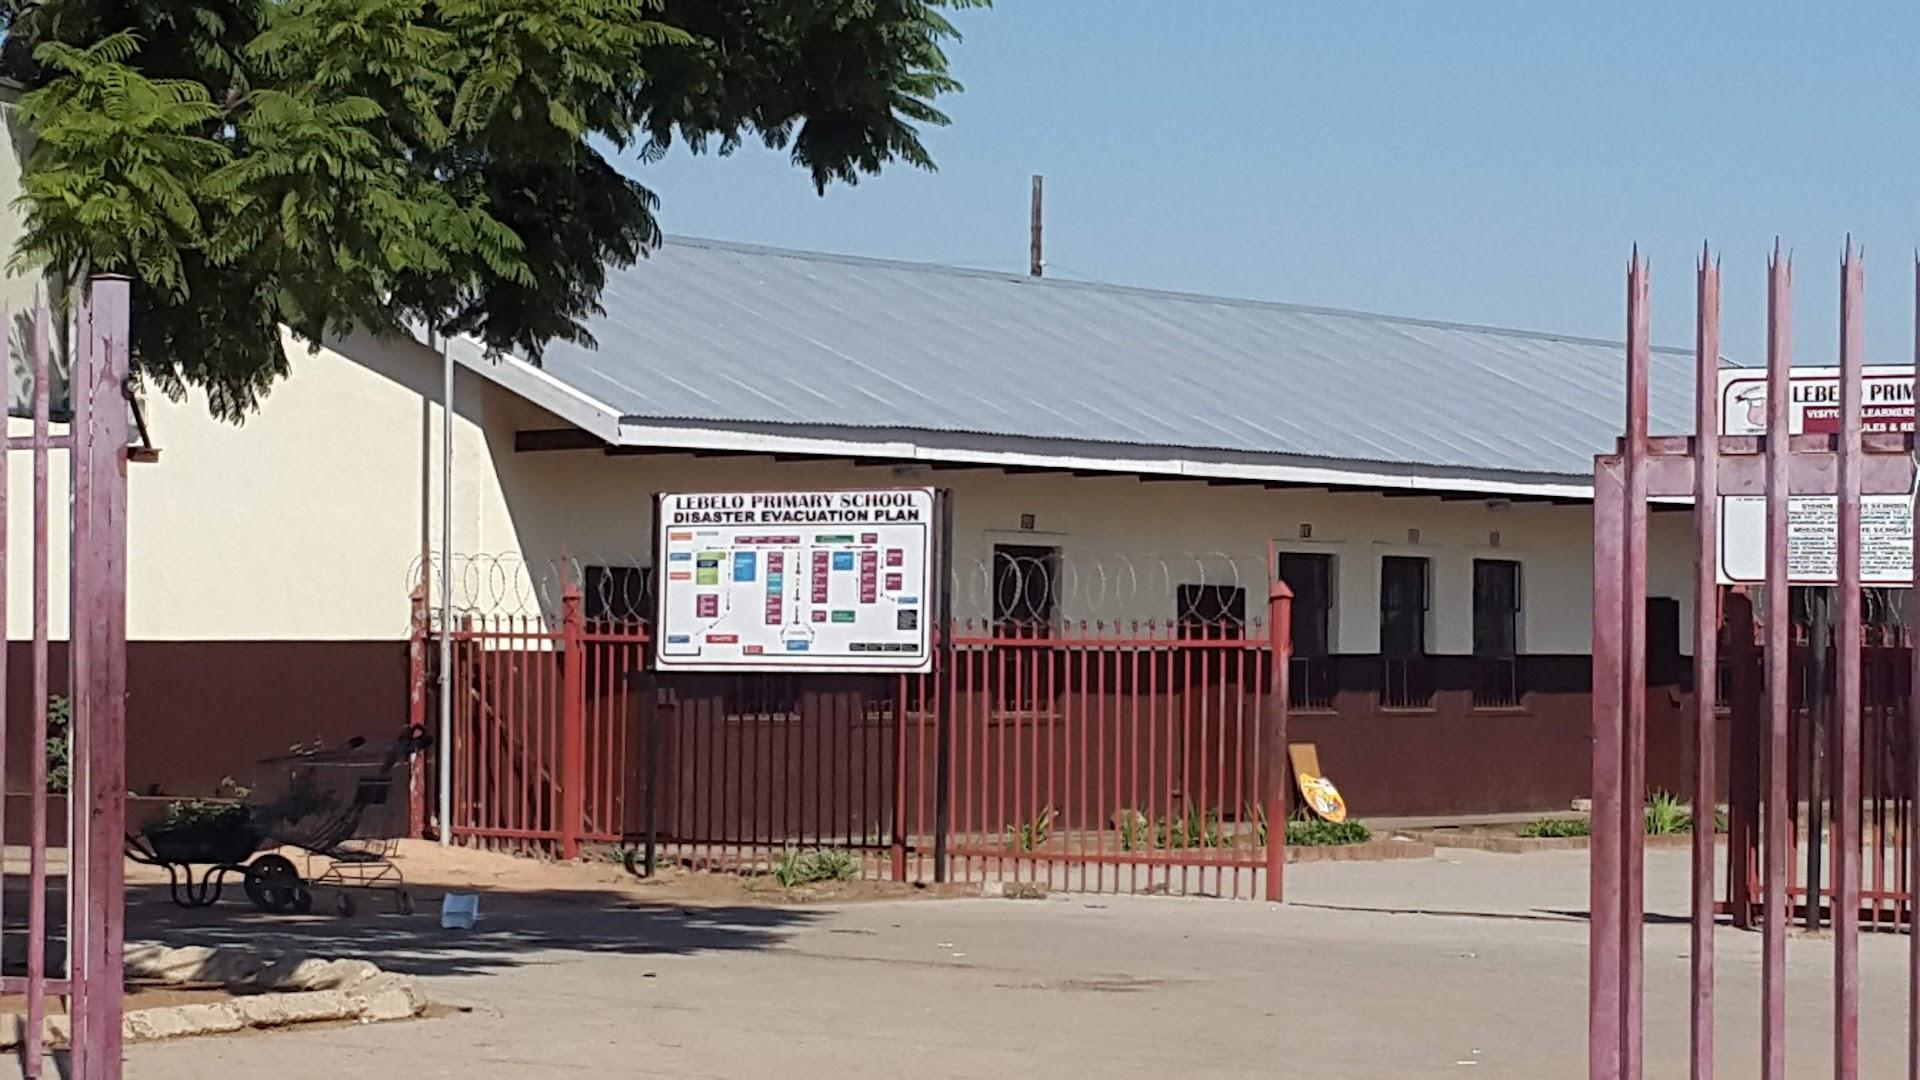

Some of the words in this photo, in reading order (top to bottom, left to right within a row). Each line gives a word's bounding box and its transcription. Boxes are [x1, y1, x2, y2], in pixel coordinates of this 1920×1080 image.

[1793, 385, 1840, 402] LEBE
[1870, 384, 1914, 401] PRIM
[676, 495, 745, 510] LEBELO
[751, 494, 834, 509] PRIMARY
[840, 493, 917, 508] SCHOOL
[674, 511, 756, 524] DISASTER
[761, 510, 869, 522] EVACUATION
[874, 509, 920, 522] PLAN
